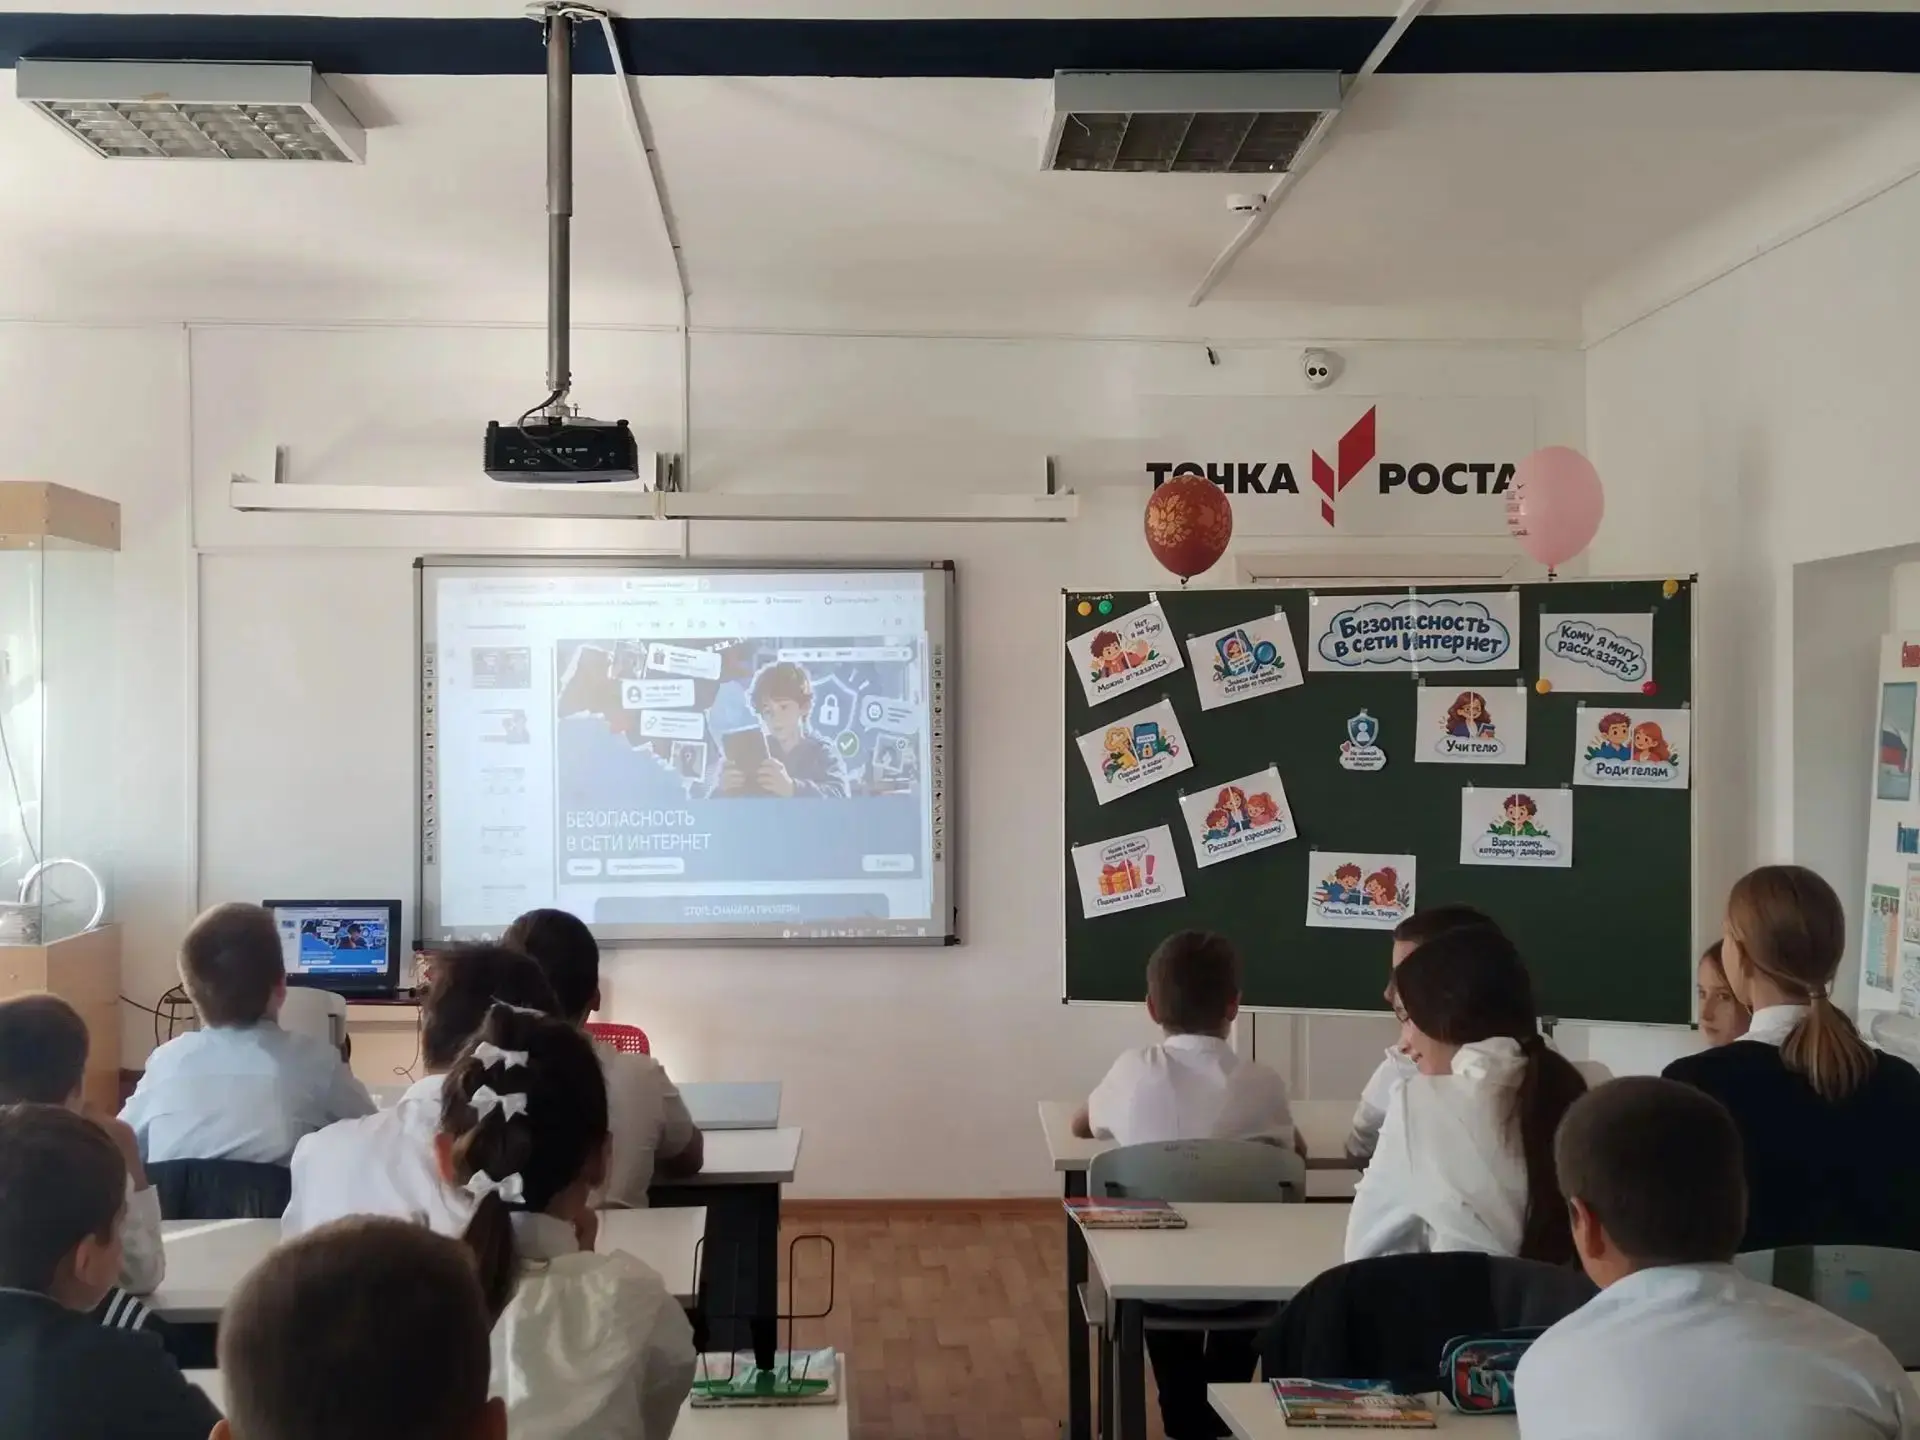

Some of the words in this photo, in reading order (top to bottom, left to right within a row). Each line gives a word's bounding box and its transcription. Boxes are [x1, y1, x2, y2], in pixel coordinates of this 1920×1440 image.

[1338, 614, 1490, 639] Безопасность
[1352, 634, 1398, 651] сети
[1402, 632, 1502, 654] Интернет
[1561, 625, 1594, 645] Кому
[1597, 637, 1606, 647] я
[1607, 641, 1639, 663] могу
[1558, 641, 1639, 676] рассказать?
[1097, 677, 1124, 693] Можно
[1126, 659, 1168, 681] отказаться
[1446, 740, 1498, 753] Учителю
[1596, 763, 1669, 777] Родителям
[566, 809, 695, 828] БЕЗОПАСНОСТЬ
[566, 835, 576, 851] В
[581, 834, 623, 851] СЕТИ
[628, 833, 712, 851] ИНТЕРНЕТ
[1207, 837, 1242, 853] Расскажи
[1245, 826, 1281, 842] взрослому
[1520, 847, 1556, 857] доверяю
